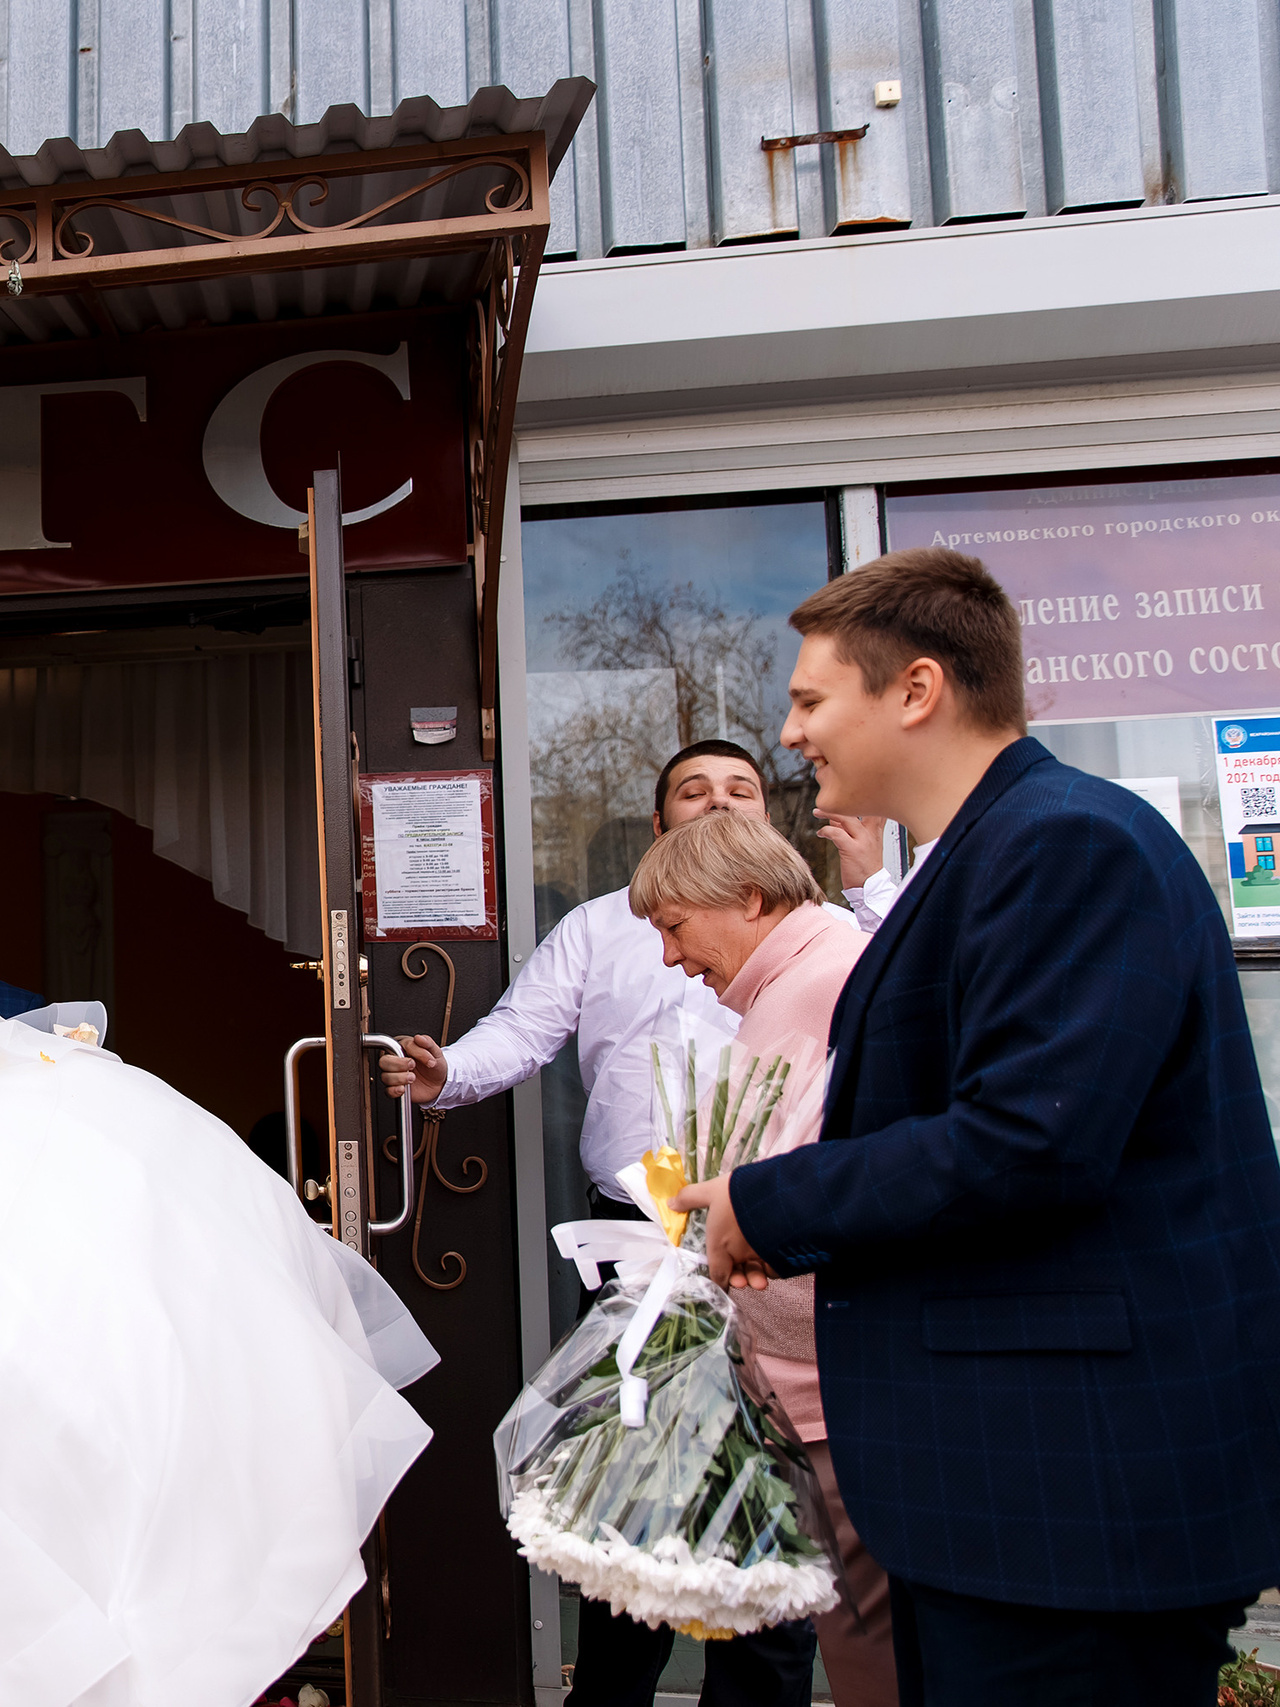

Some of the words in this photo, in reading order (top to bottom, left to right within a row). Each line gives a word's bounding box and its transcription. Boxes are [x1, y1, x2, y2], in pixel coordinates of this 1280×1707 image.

[931, 524, 1095, 550] Артемовского
[1105, 512, 1241, 538] городского
[1135, 583, 1265, 619] записи
[1025, 648, 1173, 686] анского
[428, 783, 468, 791] ГРАЖДАНЕ!
[1226, 772, 1255, 784] 2021
